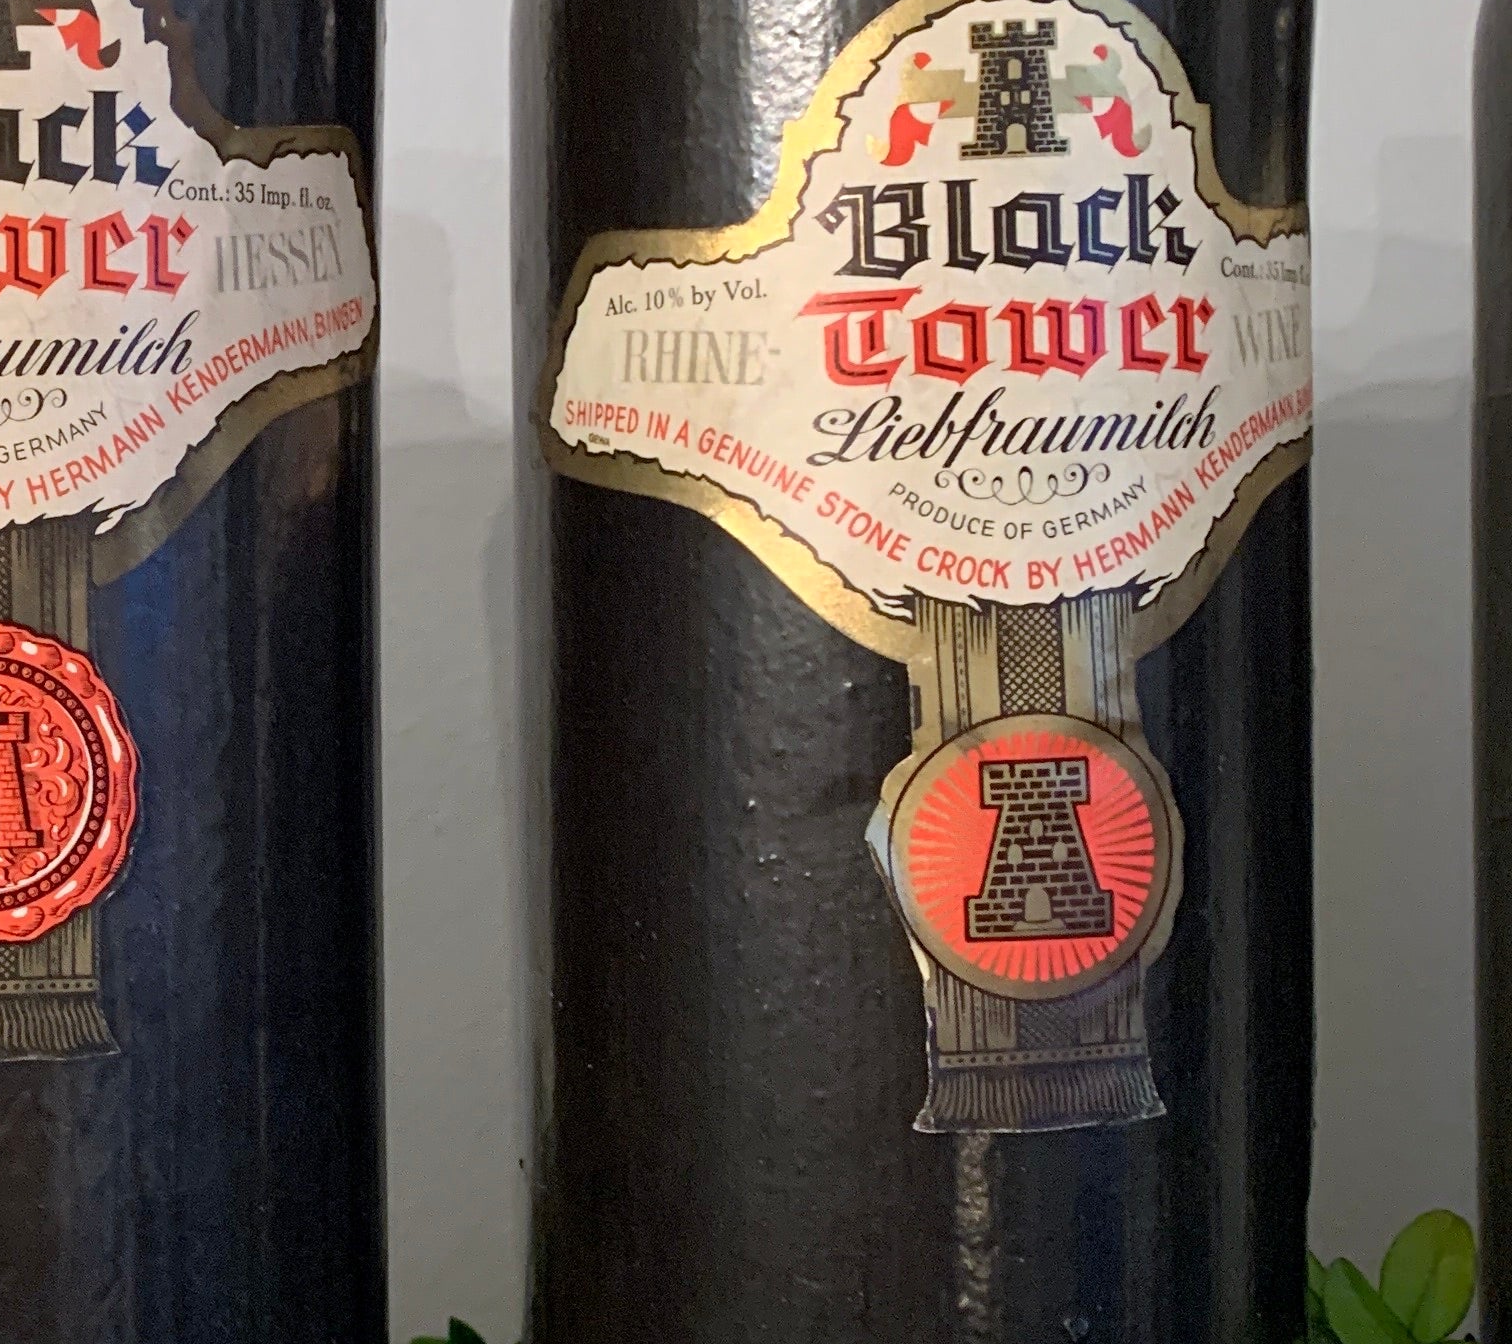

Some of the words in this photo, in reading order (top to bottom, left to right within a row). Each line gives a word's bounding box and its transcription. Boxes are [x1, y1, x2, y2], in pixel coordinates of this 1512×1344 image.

[167, 180, 230, 202] Cont.:
[234, 183, 254, 203] 35
[260, 184, 295, 208] Imp.
[299, 188, 313, 207] fl.
[316, 195, 333, 210] oz.
[814, 173, 1203, 284] Black
[214, 222, 344, 293] HESSEN
[605, 296, 637, 316] Alc.
[691, 286, 717, 312] by
[724, 279, 768, 302] Vol.
[620, 328, 781, 386] RHINE-
[793, 286, 1218, 389] Tower
[26, 404, 166, 504] HERMANN
[315, 297, 364, 340] BINGEN
[805, 384, 1218, 468] Liebfraumilch
[566, 400, 639, 433] SHIPPED
[646, 411, 671, 440] IN
[673, 419, 689, 447] A
[698, 427, 816, 502] GENUINE
[817, 491, 911, 562] STONE
[916, 546, 1012, 590] CROCK
[1028, 559, 1061, 590] BY
[1073, 484, 1196, 581] HERMANN
[888, 481, 994, 537] PRODUCE
[1005, 522, 1033, 540] OF
[1043, 475, 1148, 539] GERMANY
